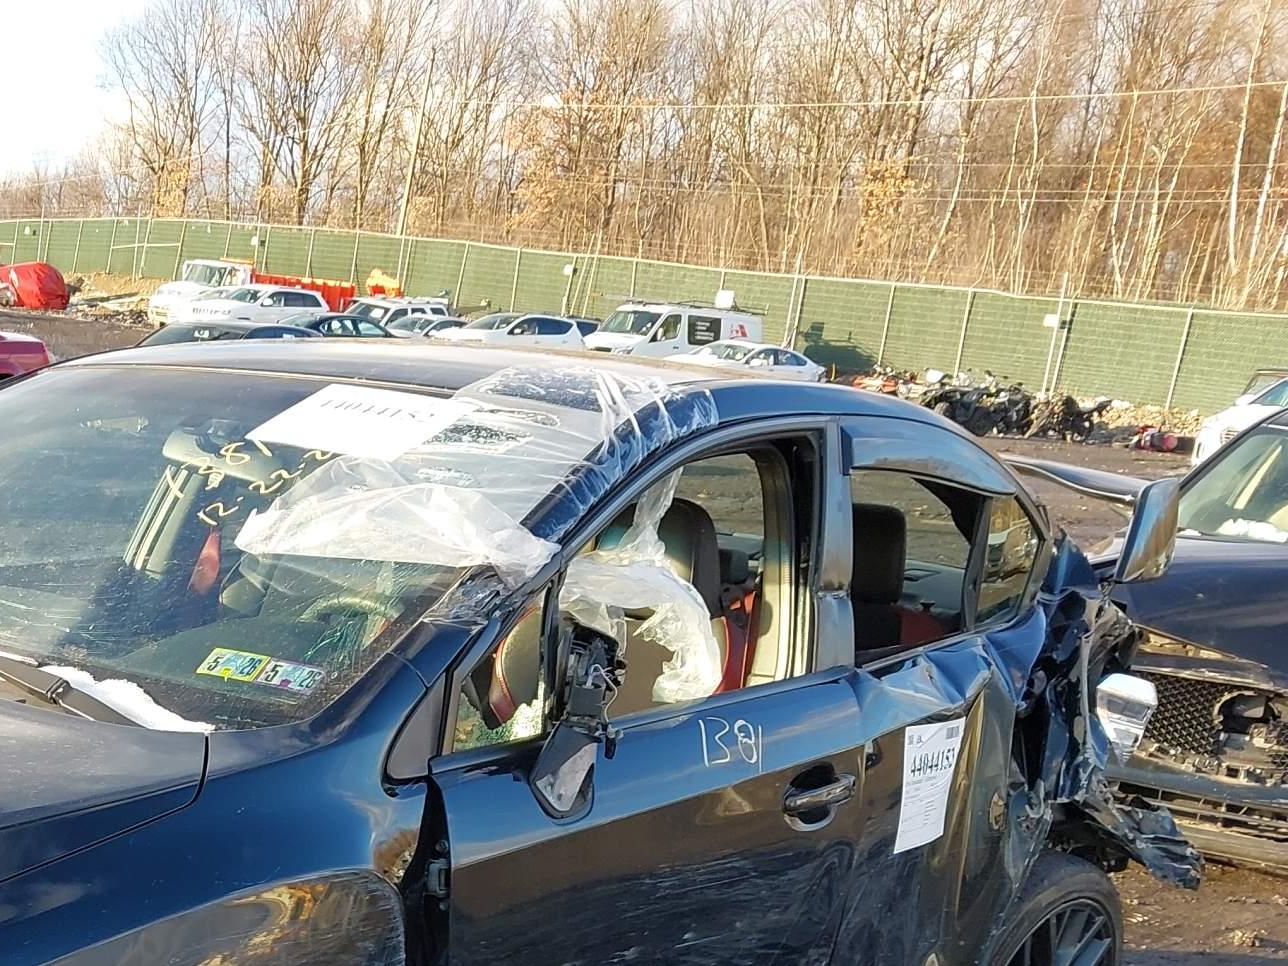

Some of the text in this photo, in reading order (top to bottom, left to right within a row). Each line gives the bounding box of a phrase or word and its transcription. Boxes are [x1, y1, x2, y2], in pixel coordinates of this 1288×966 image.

[207, 656, 262, 676] 5 26
[264, 664, 285, 682] 5
